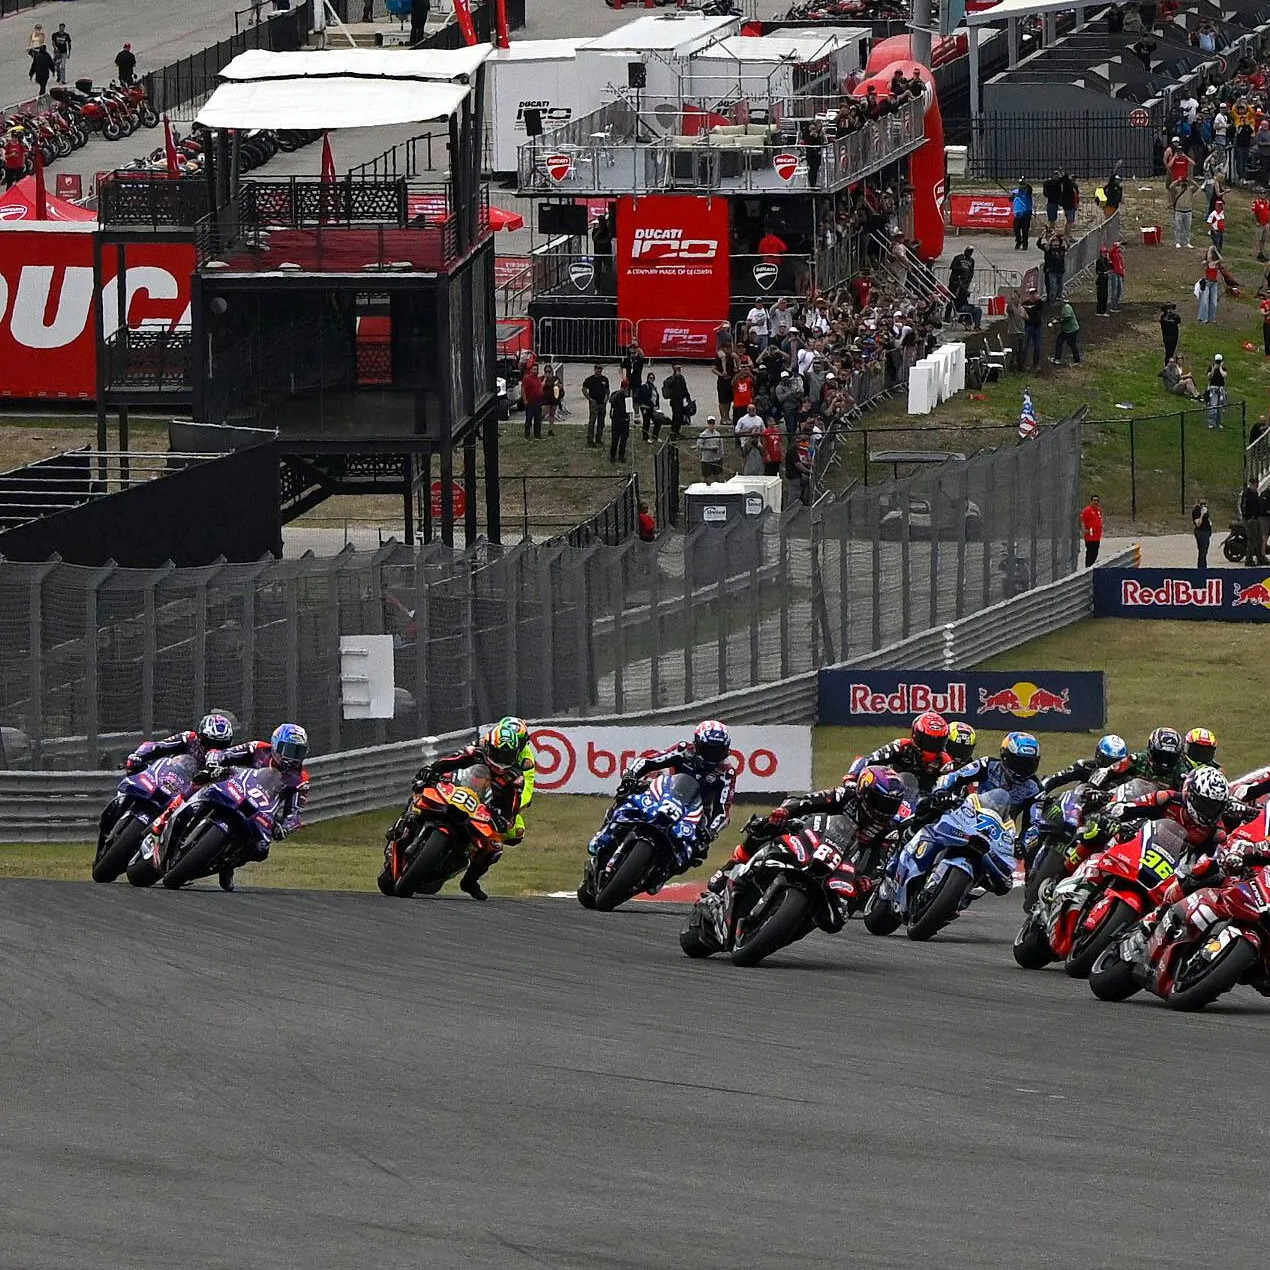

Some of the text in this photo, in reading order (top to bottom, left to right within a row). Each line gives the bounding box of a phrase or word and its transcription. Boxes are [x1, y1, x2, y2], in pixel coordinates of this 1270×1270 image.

[635, 229, 683, 239] DUCATI
[0, 266, 191, 349] UC
[1121, 579, 1223, 606] Red Bull
[850, 683, 966, 714] Red Bull
[451, 788, 478, 813] 33
[1138, 849, 1175, 880] 36
[1249, 880, 1265, 906] Lenovo
